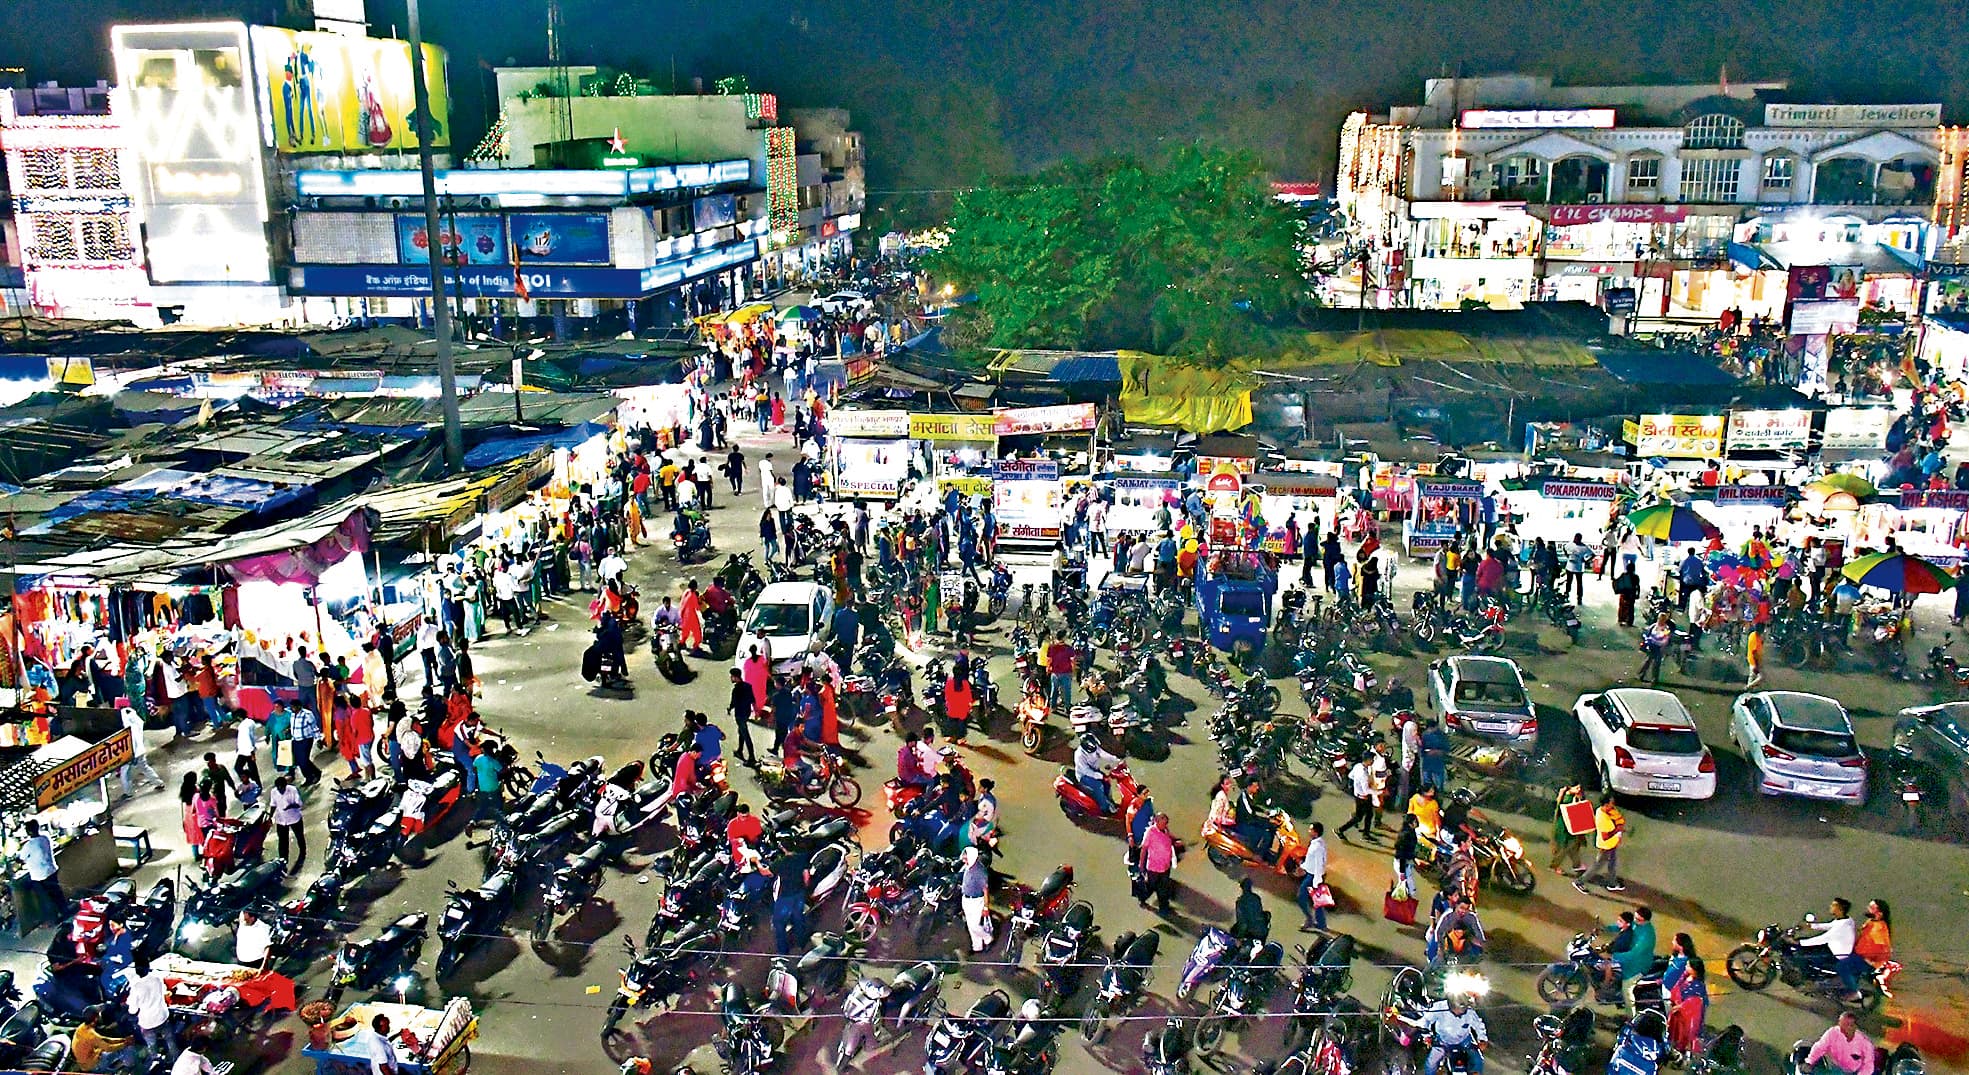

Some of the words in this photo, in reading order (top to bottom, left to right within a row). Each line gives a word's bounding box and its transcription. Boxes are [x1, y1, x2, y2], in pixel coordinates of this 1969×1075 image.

[1771, 106, 1837, 121] Trimurti
[1859, 106, 1938, 121] Jewellers
[1587, 207, 1653, 220] CHAMPS
[468, 274, 480, 285] of
[482, 274, 509, 286] India
[912, 422, 957, 434] मसाला
[1000, 460, 1036, 473] संगीता
[850, 480, 896, 491] SPECIAL
[1117, 479, 1149, 488] SANJAY
[1426, 484, 1451, 492] KAJU
[1544, 484, 1580, 497] BOKARO
[1580, 485, 1615, 498] FAMOUS
[1719, 487, 1784, 499] MILKSHAKE
[1901, 491, 1969, 508] MIKSHE
[1012, 524, 1040, 537] संगीता
[1120, 528, 1157, 537] SANJA
[52, 751, 97, 791] मसाला
